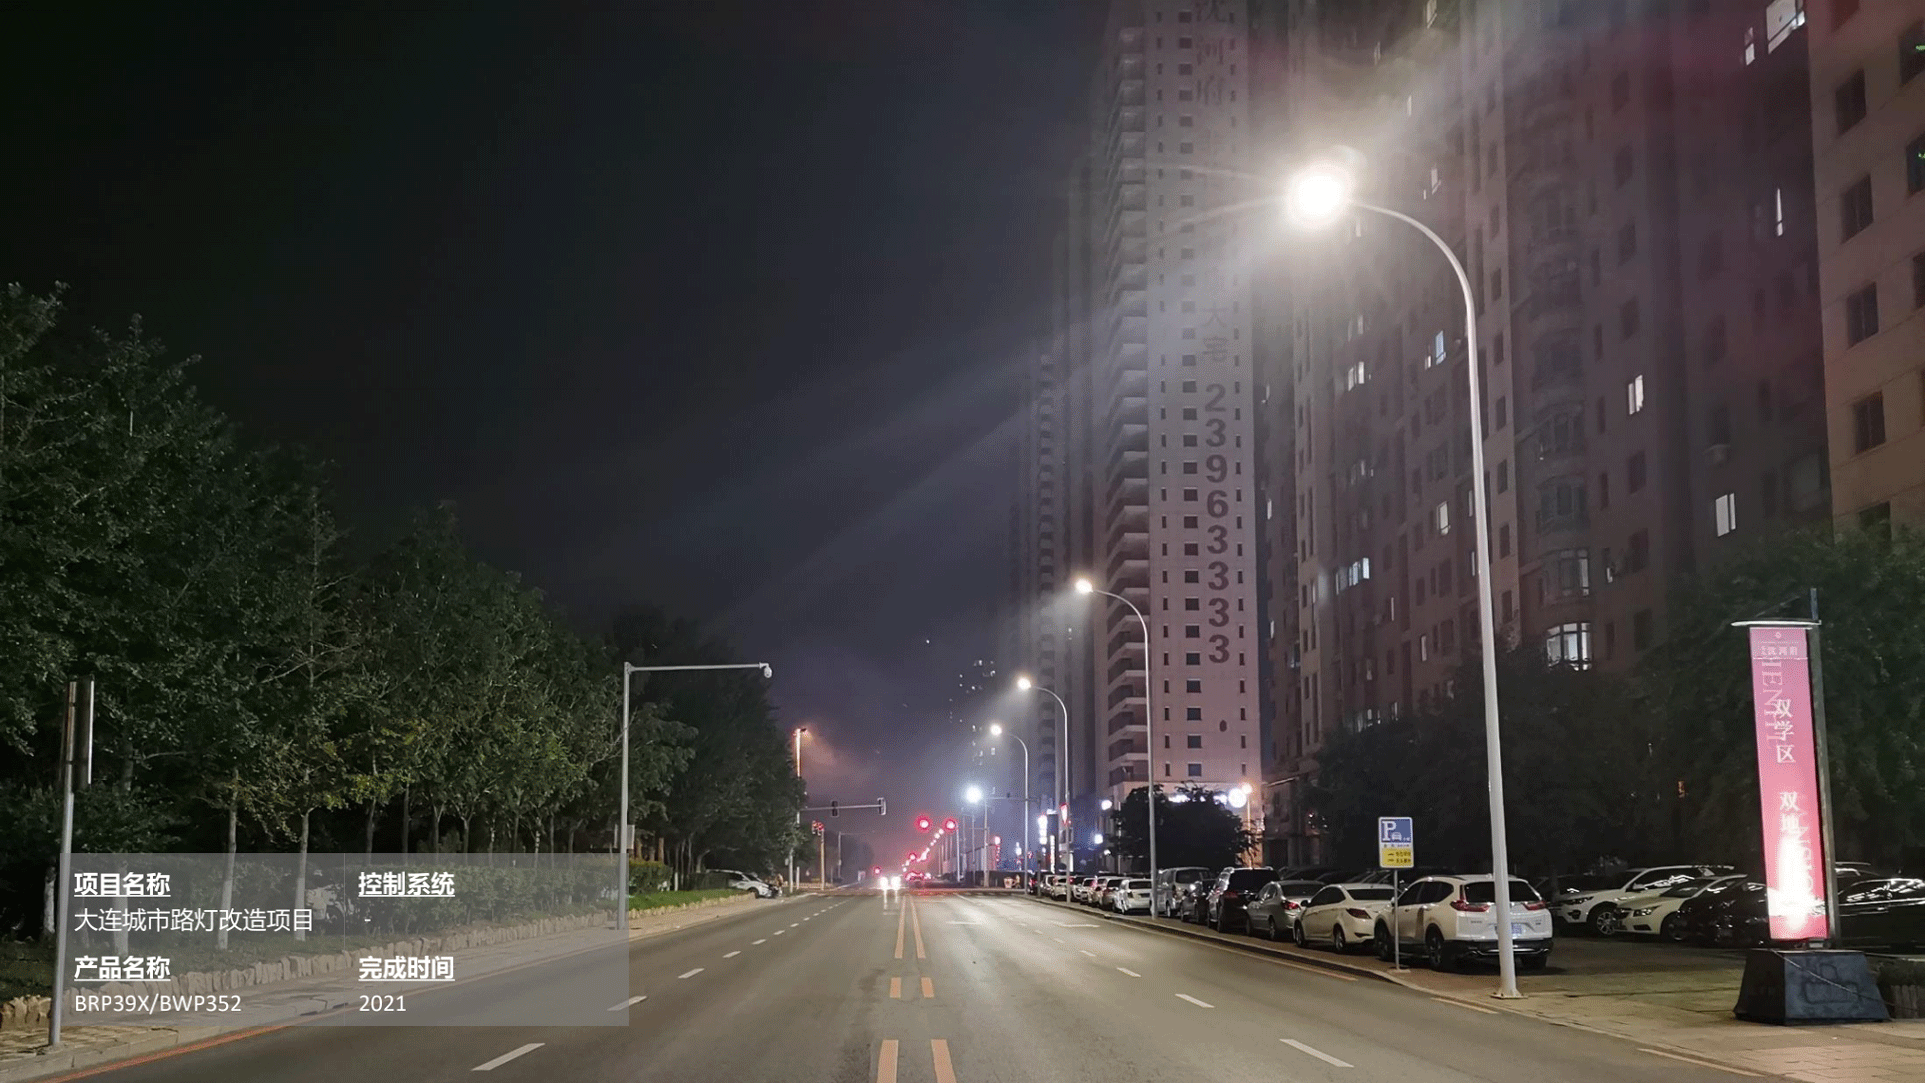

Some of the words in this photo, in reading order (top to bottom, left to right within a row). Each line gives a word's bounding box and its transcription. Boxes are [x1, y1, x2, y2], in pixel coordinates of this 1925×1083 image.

[1204, 382, 1231, 664] 23963333
[1774, 698, 1797, 765] 双学区
[1381, 820, 1397, 842] P
